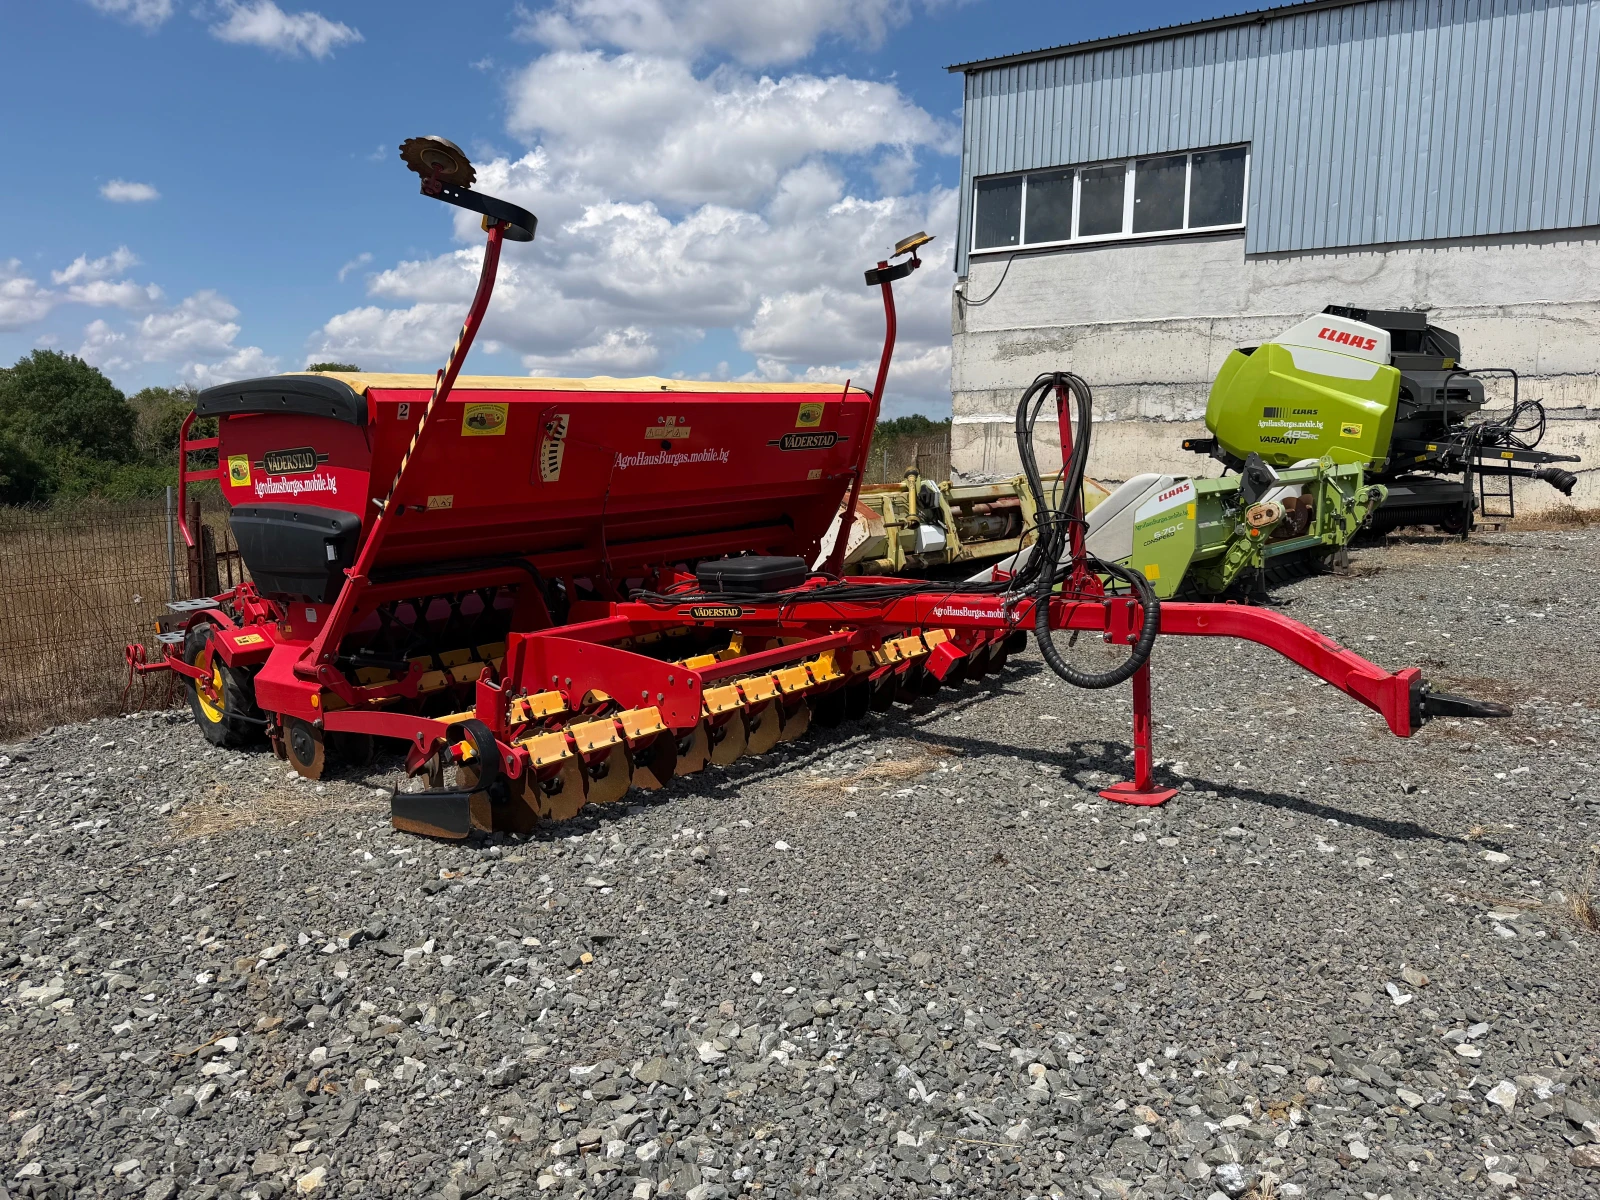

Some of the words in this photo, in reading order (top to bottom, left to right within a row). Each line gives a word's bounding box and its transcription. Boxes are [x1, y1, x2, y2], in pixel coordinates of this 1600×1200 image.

[1318, 327, 1378, 351] CLAAS
[399, 403, 409, 417] 2
[1292, 408, 1318, 416] CLAAS
[1258, 420, 1324, 429] AgroHausBurgas.mobile.bg
[784, 435, 834, 447] VÄDERSTAD
[1259, 435, 1299, 445] VARIANT
[267, 453, 313, 471] VÄDERSTAD
[614, 448, 730, 470] AgroHausBurgas.mobile.bg
[254, 473, 337, 498] AgroHausBurgas.mobile.bg
[1158, 483, 1190, 502] CLAAS
[693, 607, 739, 617] VÄDERSTAD
